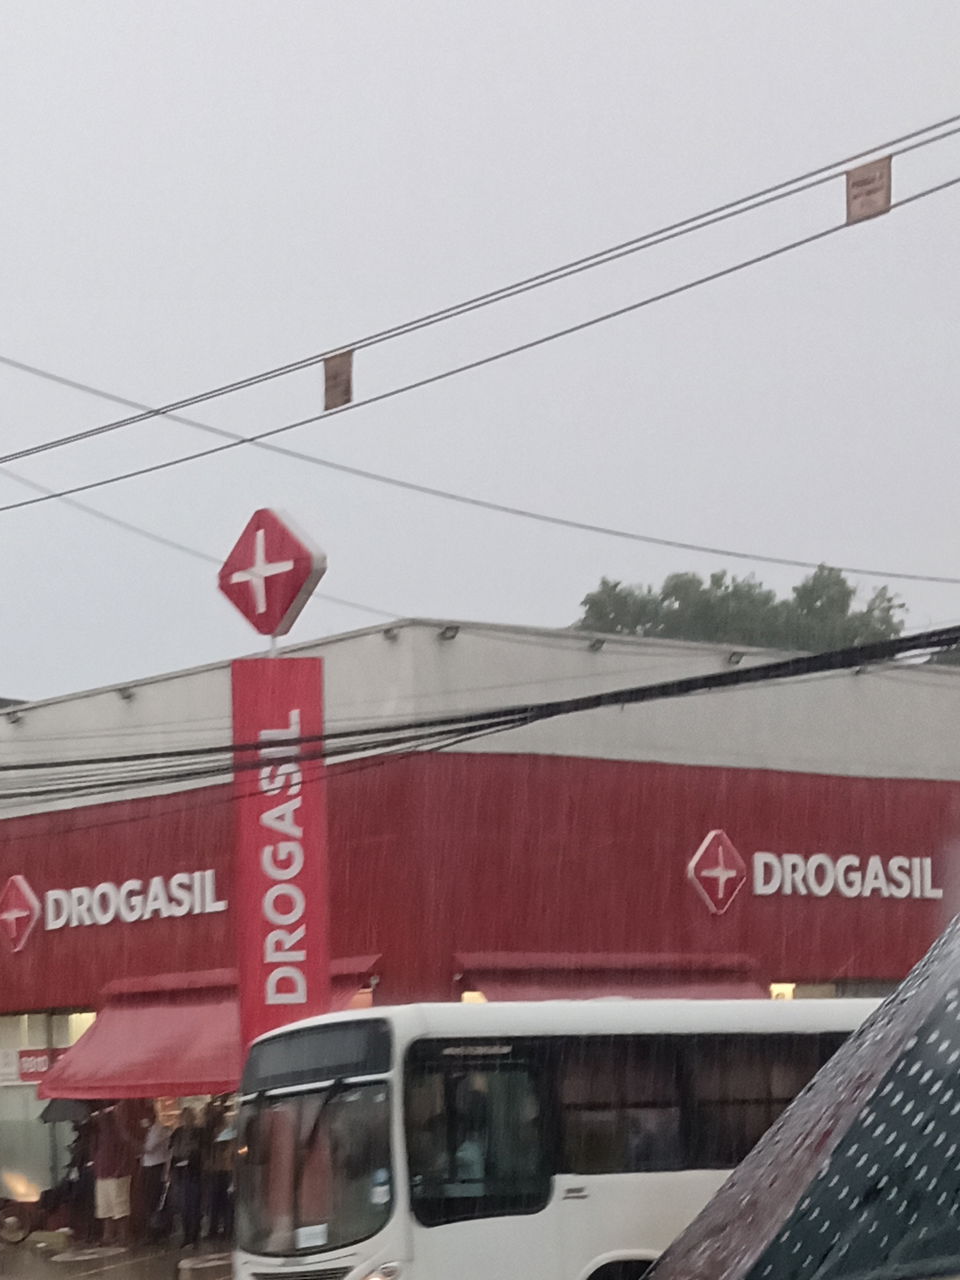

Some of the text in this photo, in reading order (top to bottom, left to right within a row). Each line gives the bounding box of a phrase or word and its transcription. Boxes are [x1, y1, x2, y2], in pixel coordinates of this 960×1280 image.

[258, 709, 307, 1005] DROGASIL
[753, 851, 943, 899] DROGASIL
[45, 869, 228, 931] DROGASIL
